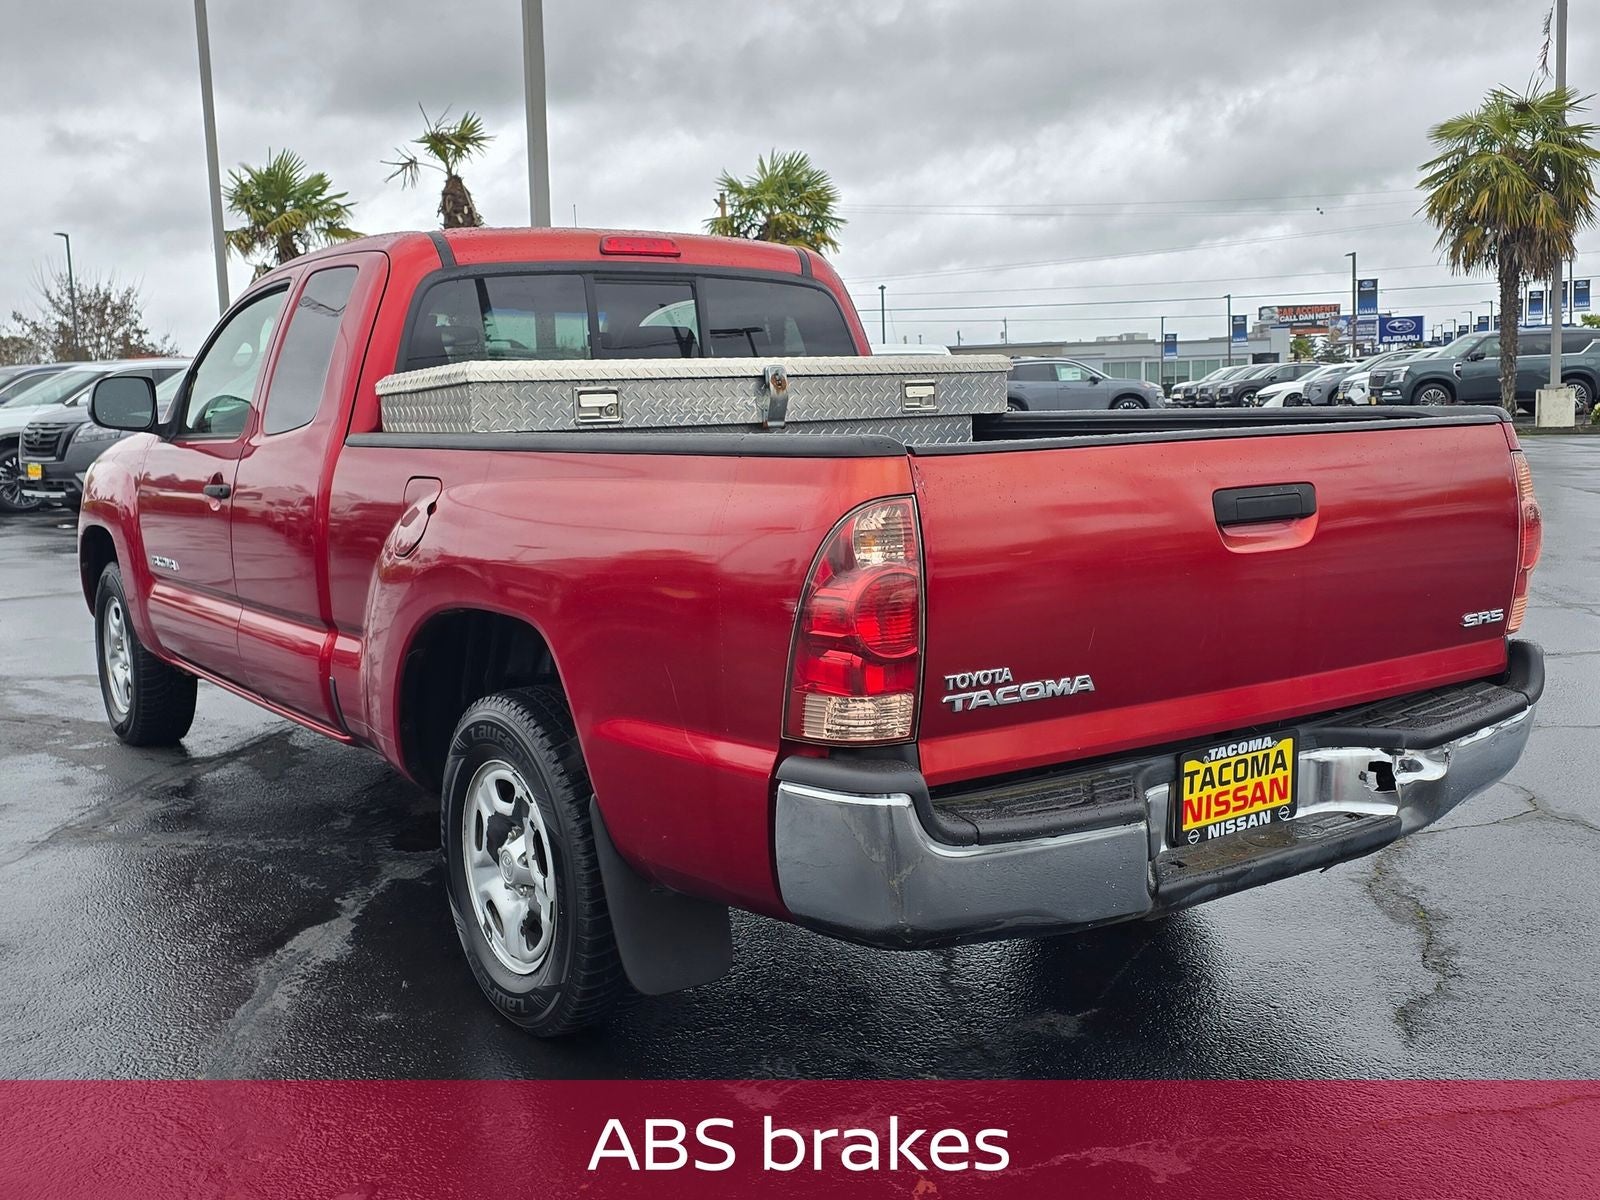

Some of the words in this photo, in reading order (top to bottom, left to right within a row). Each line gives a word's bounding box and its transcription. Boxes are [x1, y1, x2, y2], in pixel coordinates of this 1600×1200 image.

[1279, 314, 1299, 323] CALL
[1299, 312, 1315, 321] DAN
[1382, 334, 1420, 343] SUBARU
[1463, 608, 1504, 628] SR5
[944, 667, 1014, 691] TOYOTA
[942, 674, 1096, 713] TACOMA
[1208, 736, 1273, 762] TACOMA
[1184, 749, 1288, 795] TACOMA
[1183, 775, 1289, 825] NISSAN
[1207, 809, 1271, 840] NISSAN
